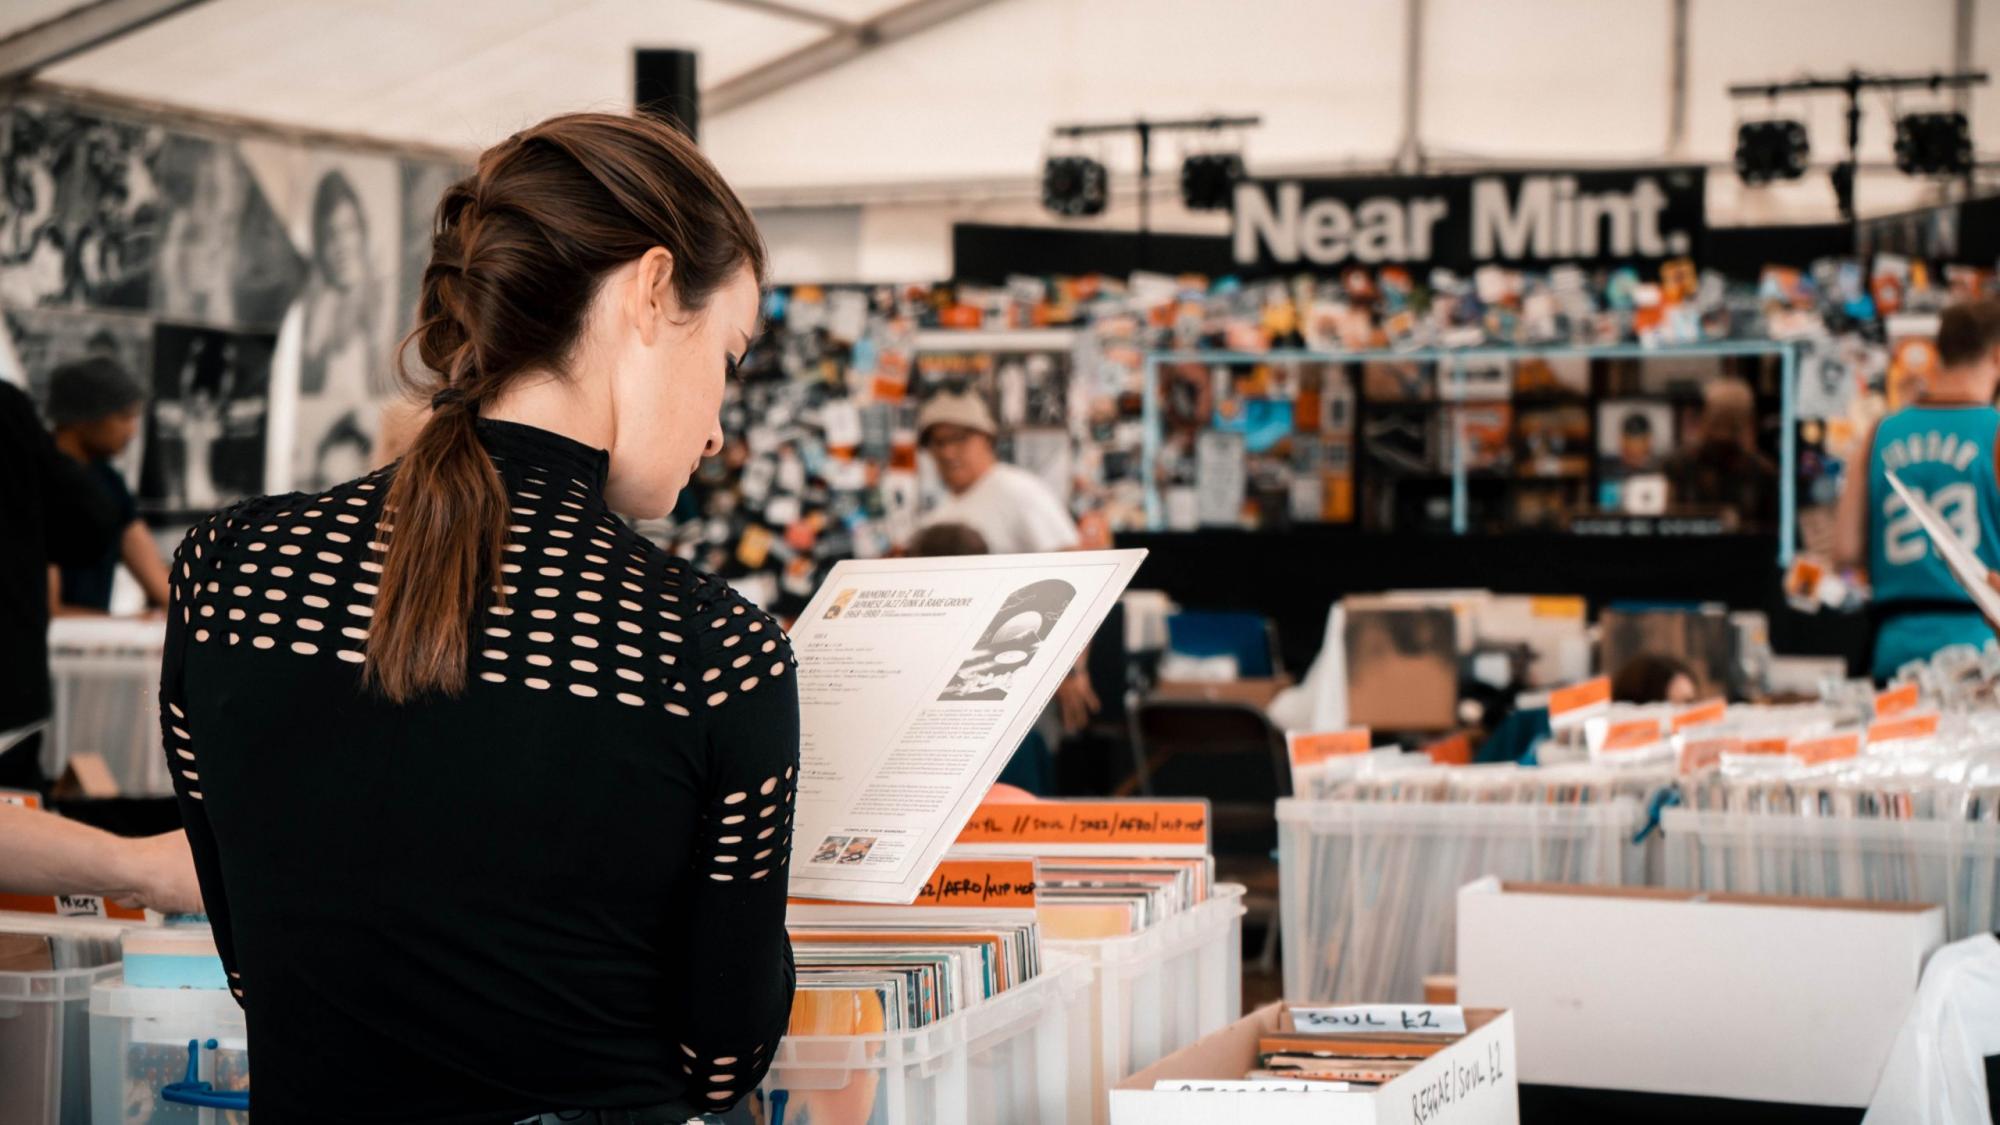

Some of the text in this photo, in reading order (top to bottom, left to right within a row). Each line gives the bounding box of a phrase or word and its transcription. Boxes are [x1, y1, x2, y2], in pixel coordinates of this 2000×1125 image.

[1233, 175, 1690, 264] Near Mint.
[1883, 482, 1980, 566] 23
[851, 599, 884, 608] JAPANESE
[883, 599, 901, 608] JAZZ
[899, 598, 920, 607] FUNK
[925, 598, 945, 607] RARE
[943, 597, 974, 607] GROOVE
[1014, 881, 1037, 895] HOP
[1308, 1012, 1386, 1026] SOUL
